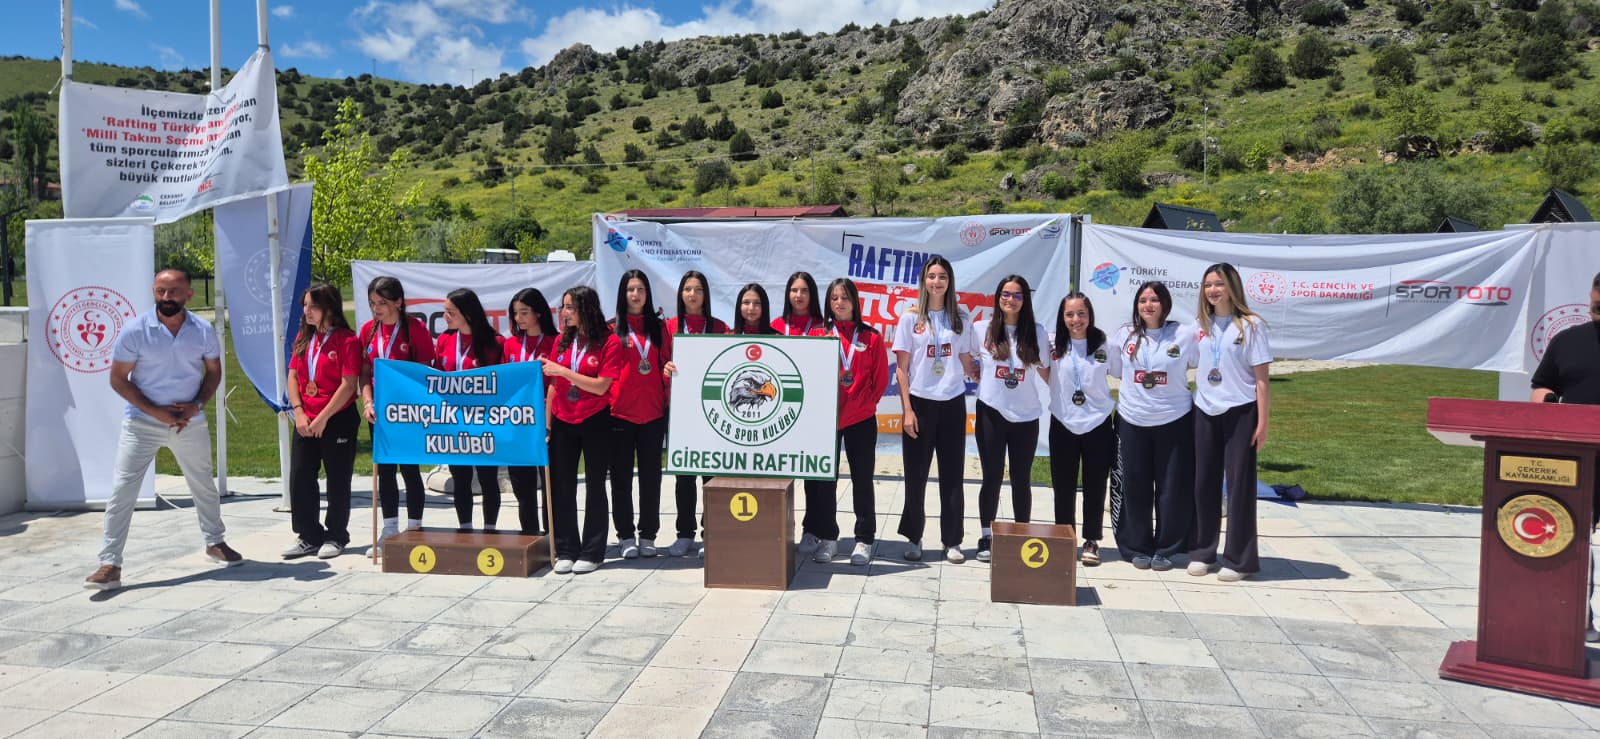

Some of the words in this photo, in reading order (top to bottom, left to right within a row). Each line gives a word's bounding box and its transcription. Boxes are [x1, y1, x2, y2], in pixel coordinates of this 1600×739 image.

[141, 104, 204, 120] İlçemizde
[122, 132, 161, 144] Takım
[166, 135, 204, 147] Seçme
[90, 142, 116, 154] tüm
[106, 157, 146, 169] sizleri
[120, 171, 158, 184] büyük
[1130, 266, 1168, 276] TÜRKİYE
[1292, 281, 1309, 289] T.C.
[1312, 282, 1356, 290] GENÇLİK
[1291, 290, 1317, 298] SPOR
[1319, 291, 1374, 300] BAKANLIĞI
[426, 371, 497, 394] TUNCELİ
[385, 401, 458, 428] GENÇLİK
[462, 405, 485, 425] VE
[488, 405, 536, 425] SPOR
[708, 408, 718, 425] ES
[720, 420, 732, 435] ES
[734, 428, 759, 442] SPOR
[762, 407, 796, 440] KULÜBÜ
[425, 432, 495, 454] KULÜBÜ
[671, 446, 747, 470] GİRESUN
[753, 451, 832, 473] RAFTİNG
[1505, 472, 1570, 483] KAYMAKAMLIĞI
[1517, 466, 1558, 475] ÇEKEREK
[736, 495, 754, 517] 1
[417, 552, 428, 566] 4
[1028, 542, 1044, 563] 2
[486, 554, 496, 568] 3
